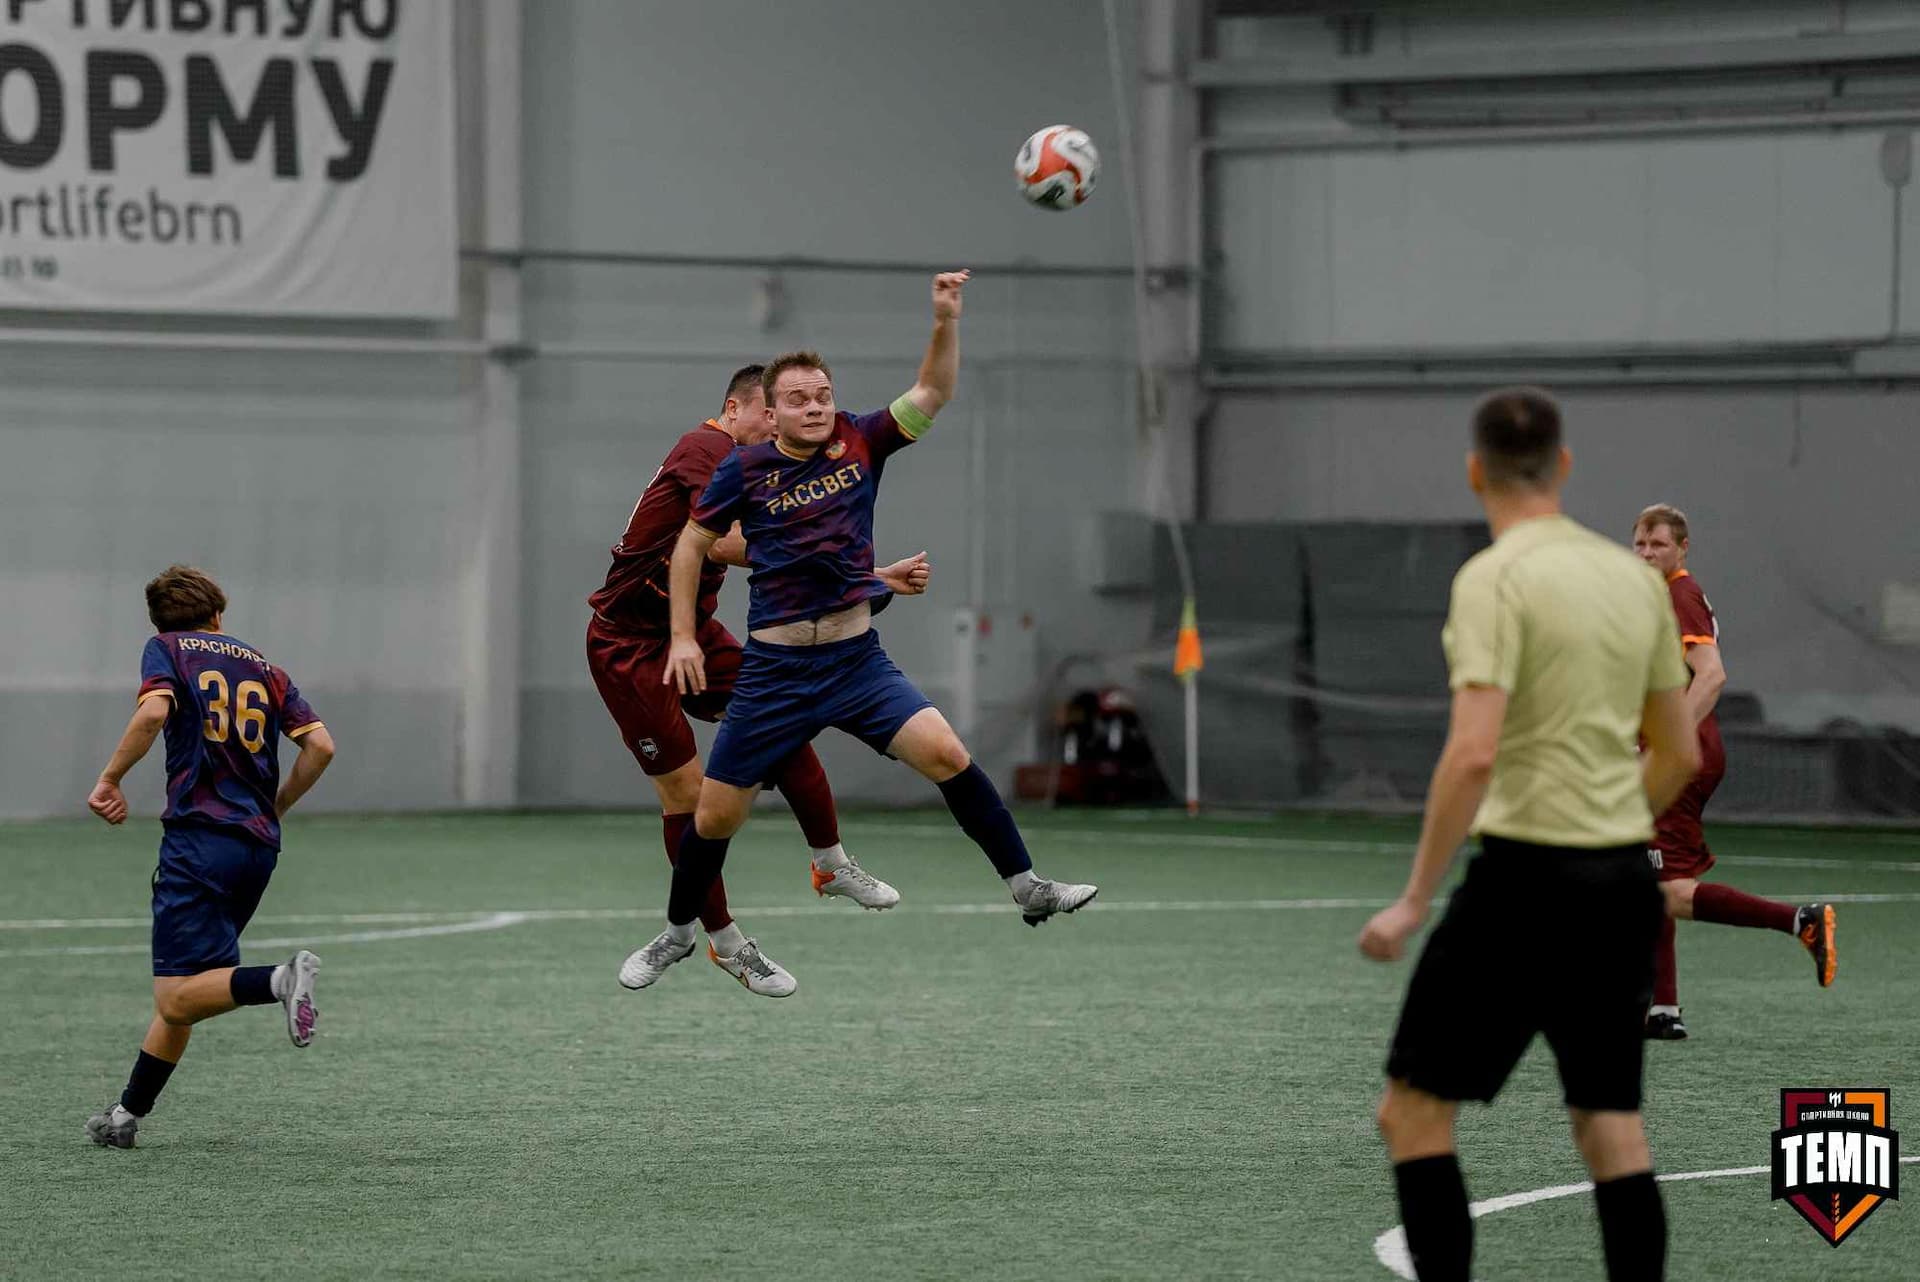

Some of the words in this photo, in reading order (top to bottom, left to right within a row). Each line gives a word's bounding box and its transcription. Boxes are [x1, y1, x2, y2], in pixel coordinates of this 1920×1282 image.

[0, 43, 394, 183] ОРМУ
[0, 185, 242, 245] rtlifebrn
[198, 669, 269, 754] 36
